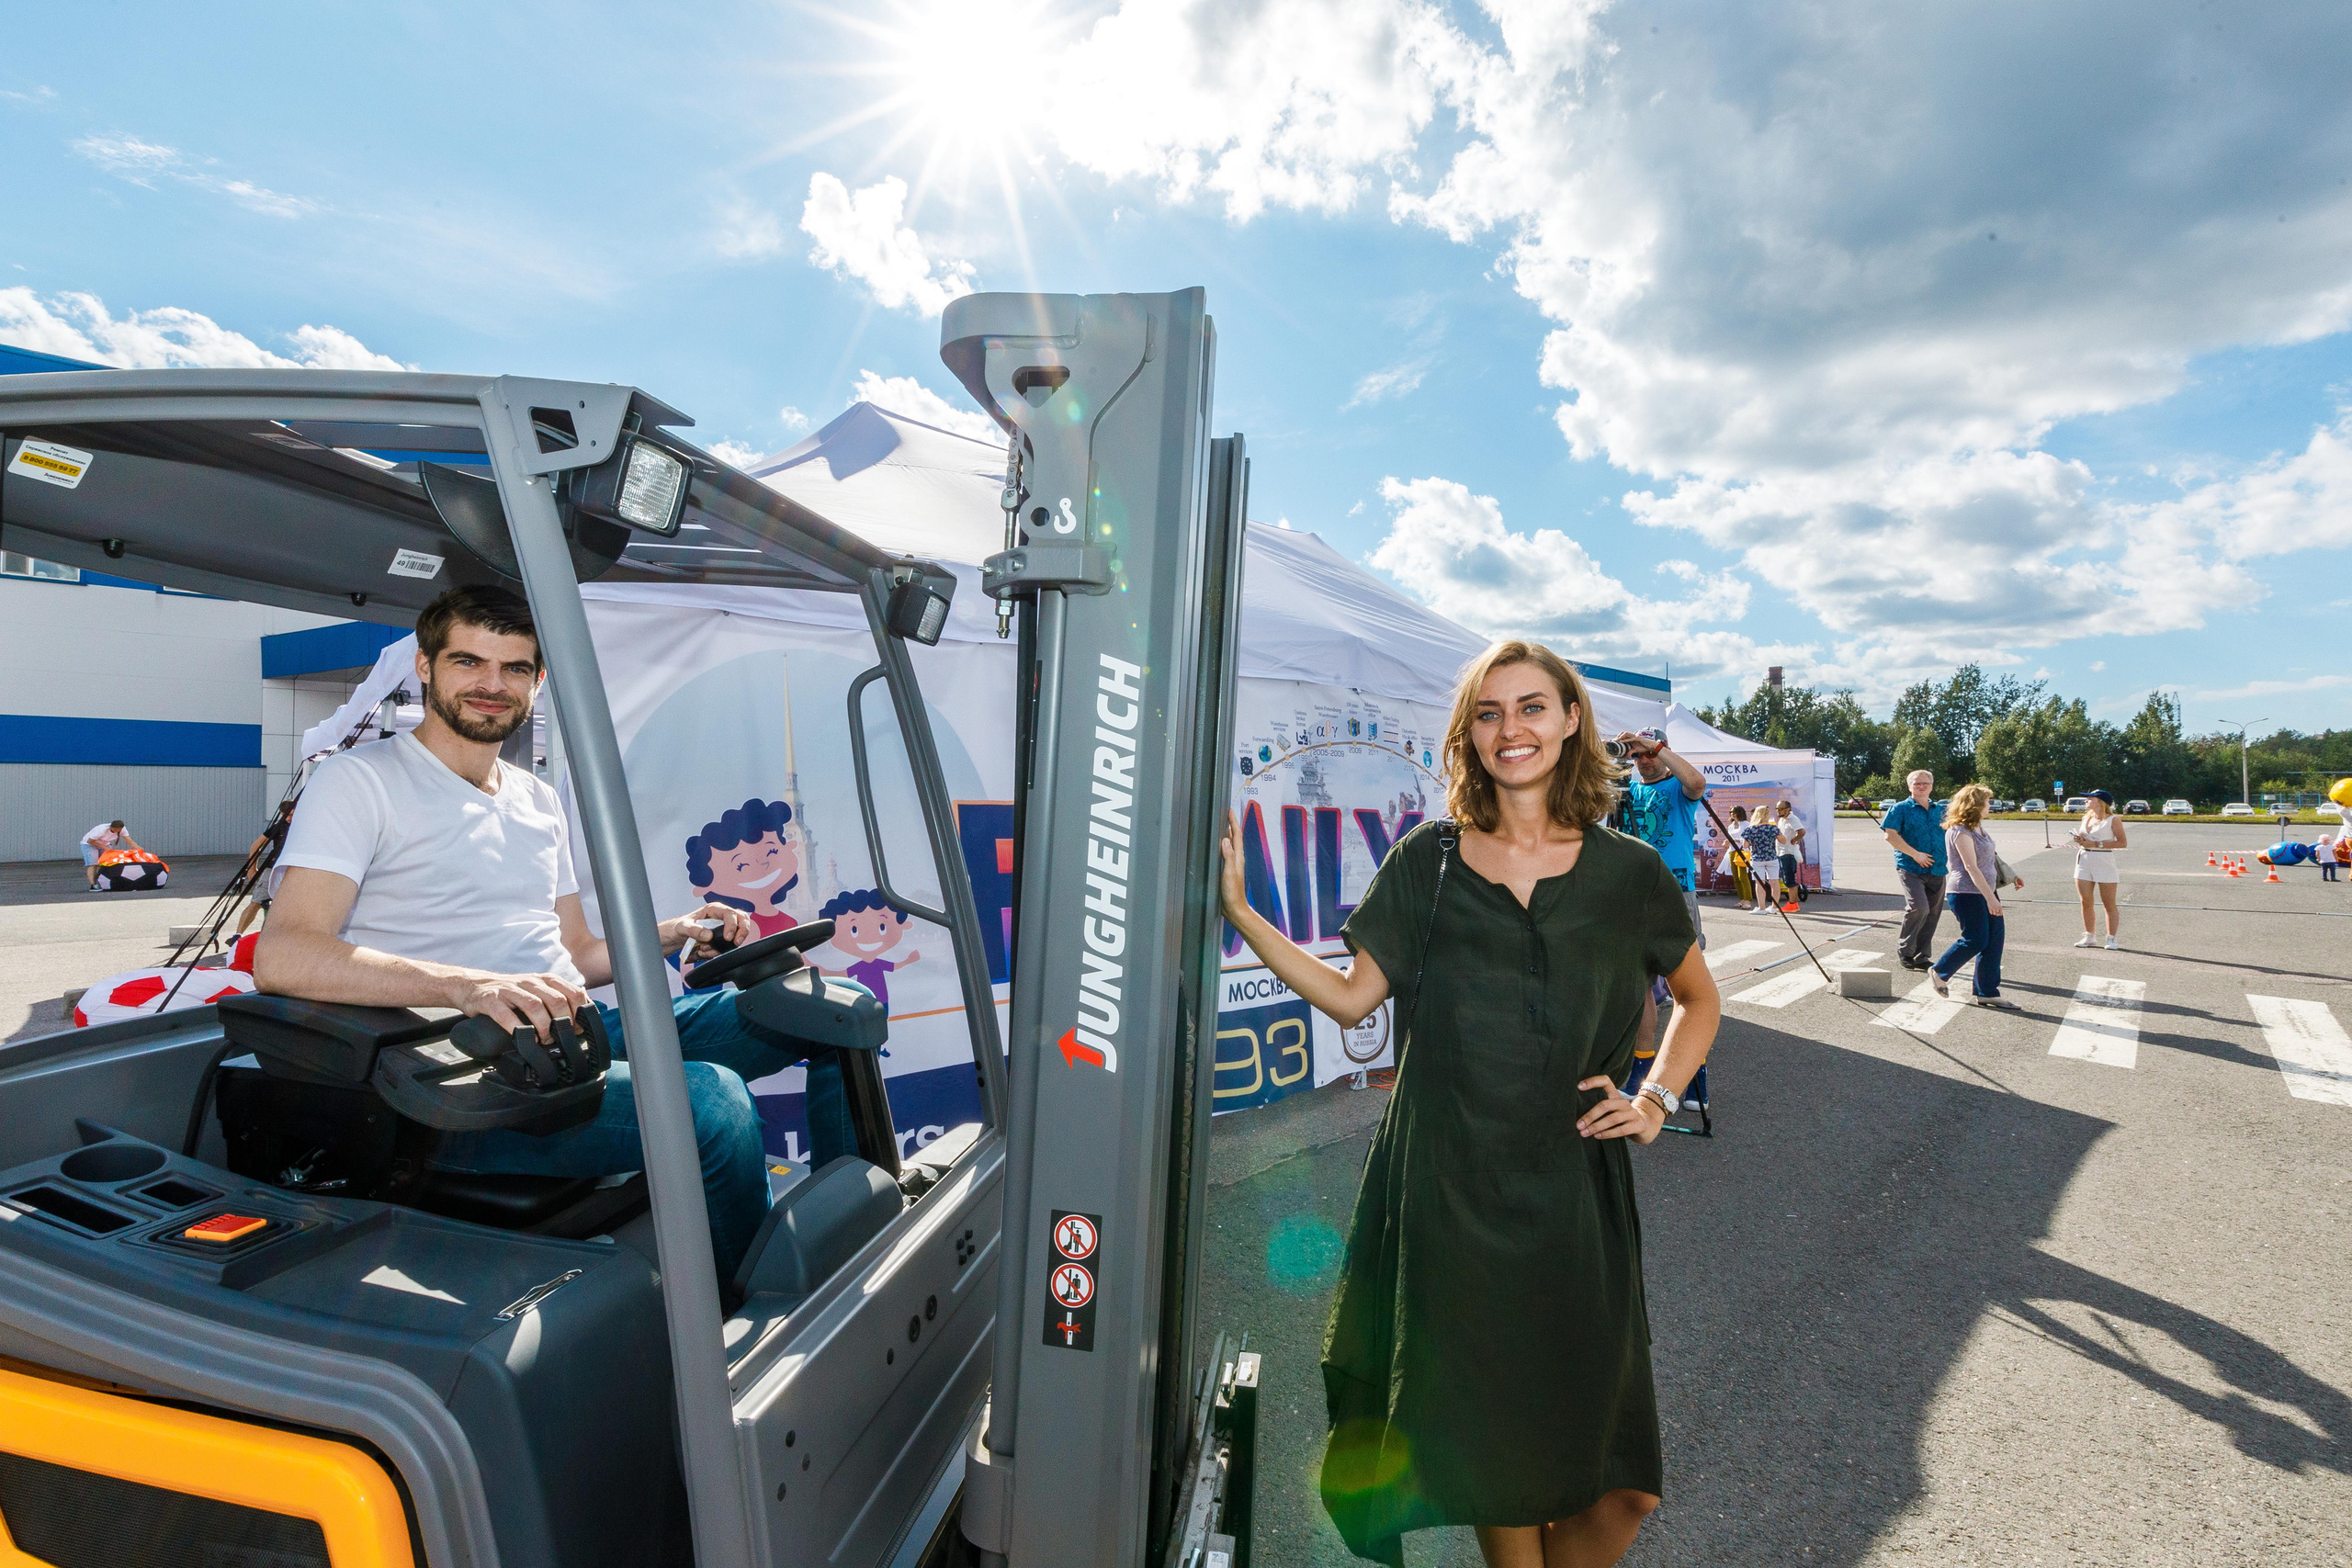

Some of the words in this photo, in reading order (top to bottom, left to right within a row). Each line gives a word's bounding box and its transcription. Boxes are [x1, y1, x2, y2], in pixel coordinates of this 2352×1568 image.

[29, 457, 44, 465] 800
[44, 461, 57, 469] 555
[1703, 764, 1758, 774] МОСКВА
[1243, 786, 1259, 795] 1993
[1076, 653, 1141, 1074] JUNGHEINRICH
[1356, 1032, 1374, 1040] YEARS
